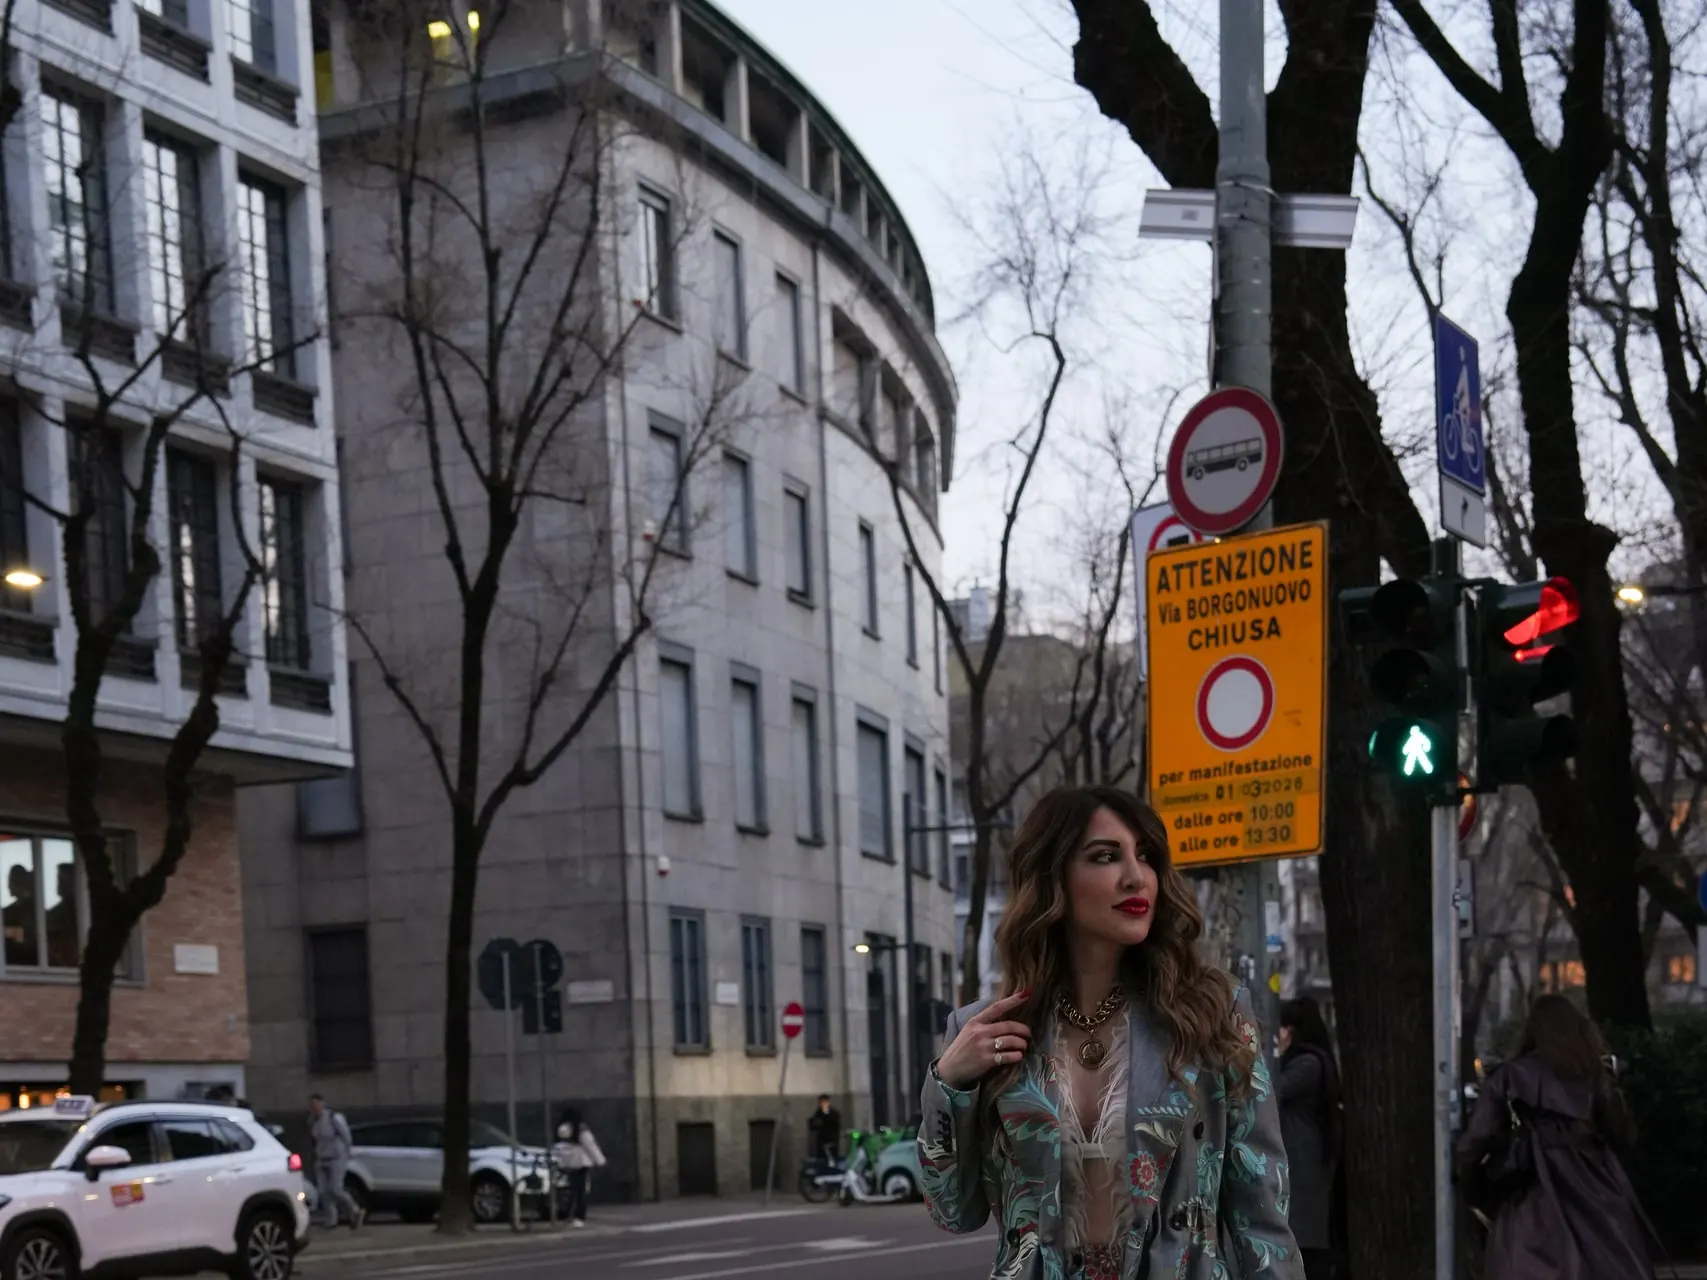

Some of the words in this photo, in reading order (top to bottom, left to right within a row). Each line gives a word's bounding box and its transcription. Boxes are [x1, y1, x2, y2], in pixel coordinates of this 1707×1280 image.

[1157, 540, 1313, 594] ATTENZIONE
[1159, 602, 1181, 625] Via
[1187, 579, 1312, 620] BORGONUOVO
[1188, 616, 1281, 651] CHIUSA
[1159, 770, 1183, 786] per
[1189, 754, 1313, 781] manifestazione
[1174, 813, 1213, 830] dalle
[1218, 810, 1243, 824] ore
[1250, 802, 1295, 821] 10:00
[1180, 836, 1208, 853] alle
[1213, 834, 1239, 849] ore
